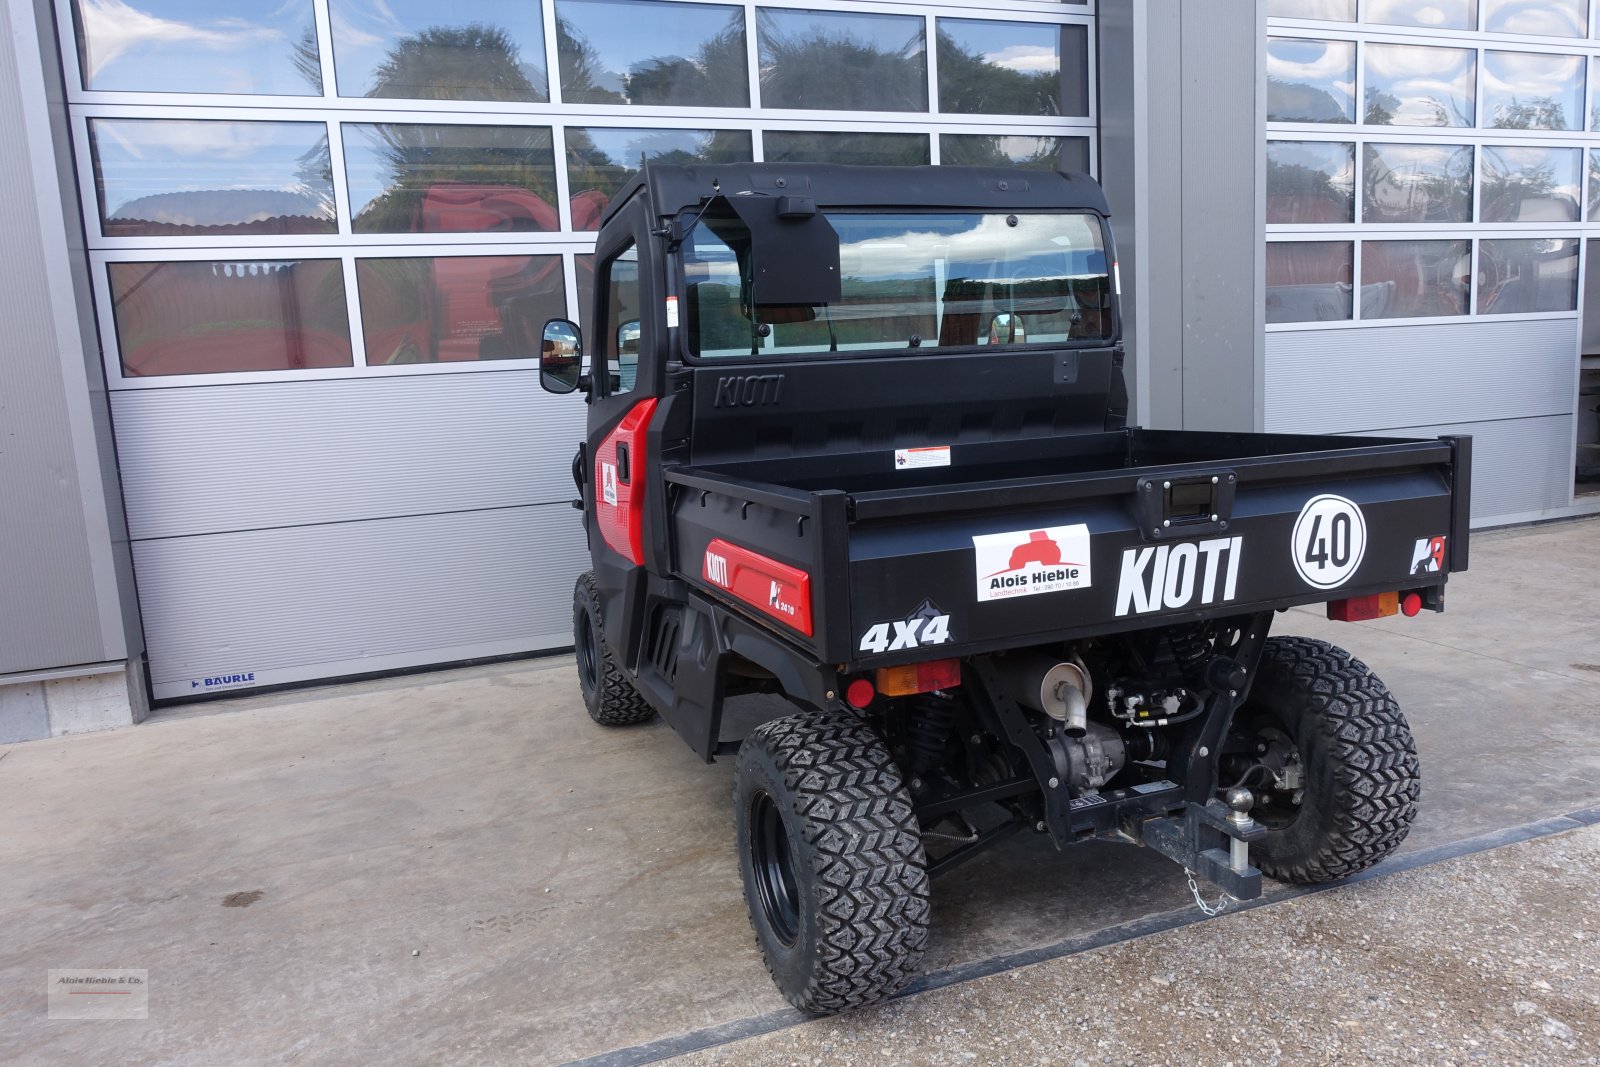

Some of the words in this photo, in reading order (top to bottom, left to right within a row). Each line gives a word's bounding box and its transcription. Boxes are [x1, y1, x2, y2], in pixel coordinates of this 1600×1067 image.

[714, 374, 785, 409] KIOTI
[1305, 512, 1352, 570] 40
[706, 551, 729, 588] KIOTI
[990, 574, 1028, 590] Alois
[1032, 568, 1079, 584] Hieble
[1114, 536, 1243, 617] KIOTI
[989, 587, 1028, 598] Landtechnik
[204, 672, 255, 687] BÄURLE
